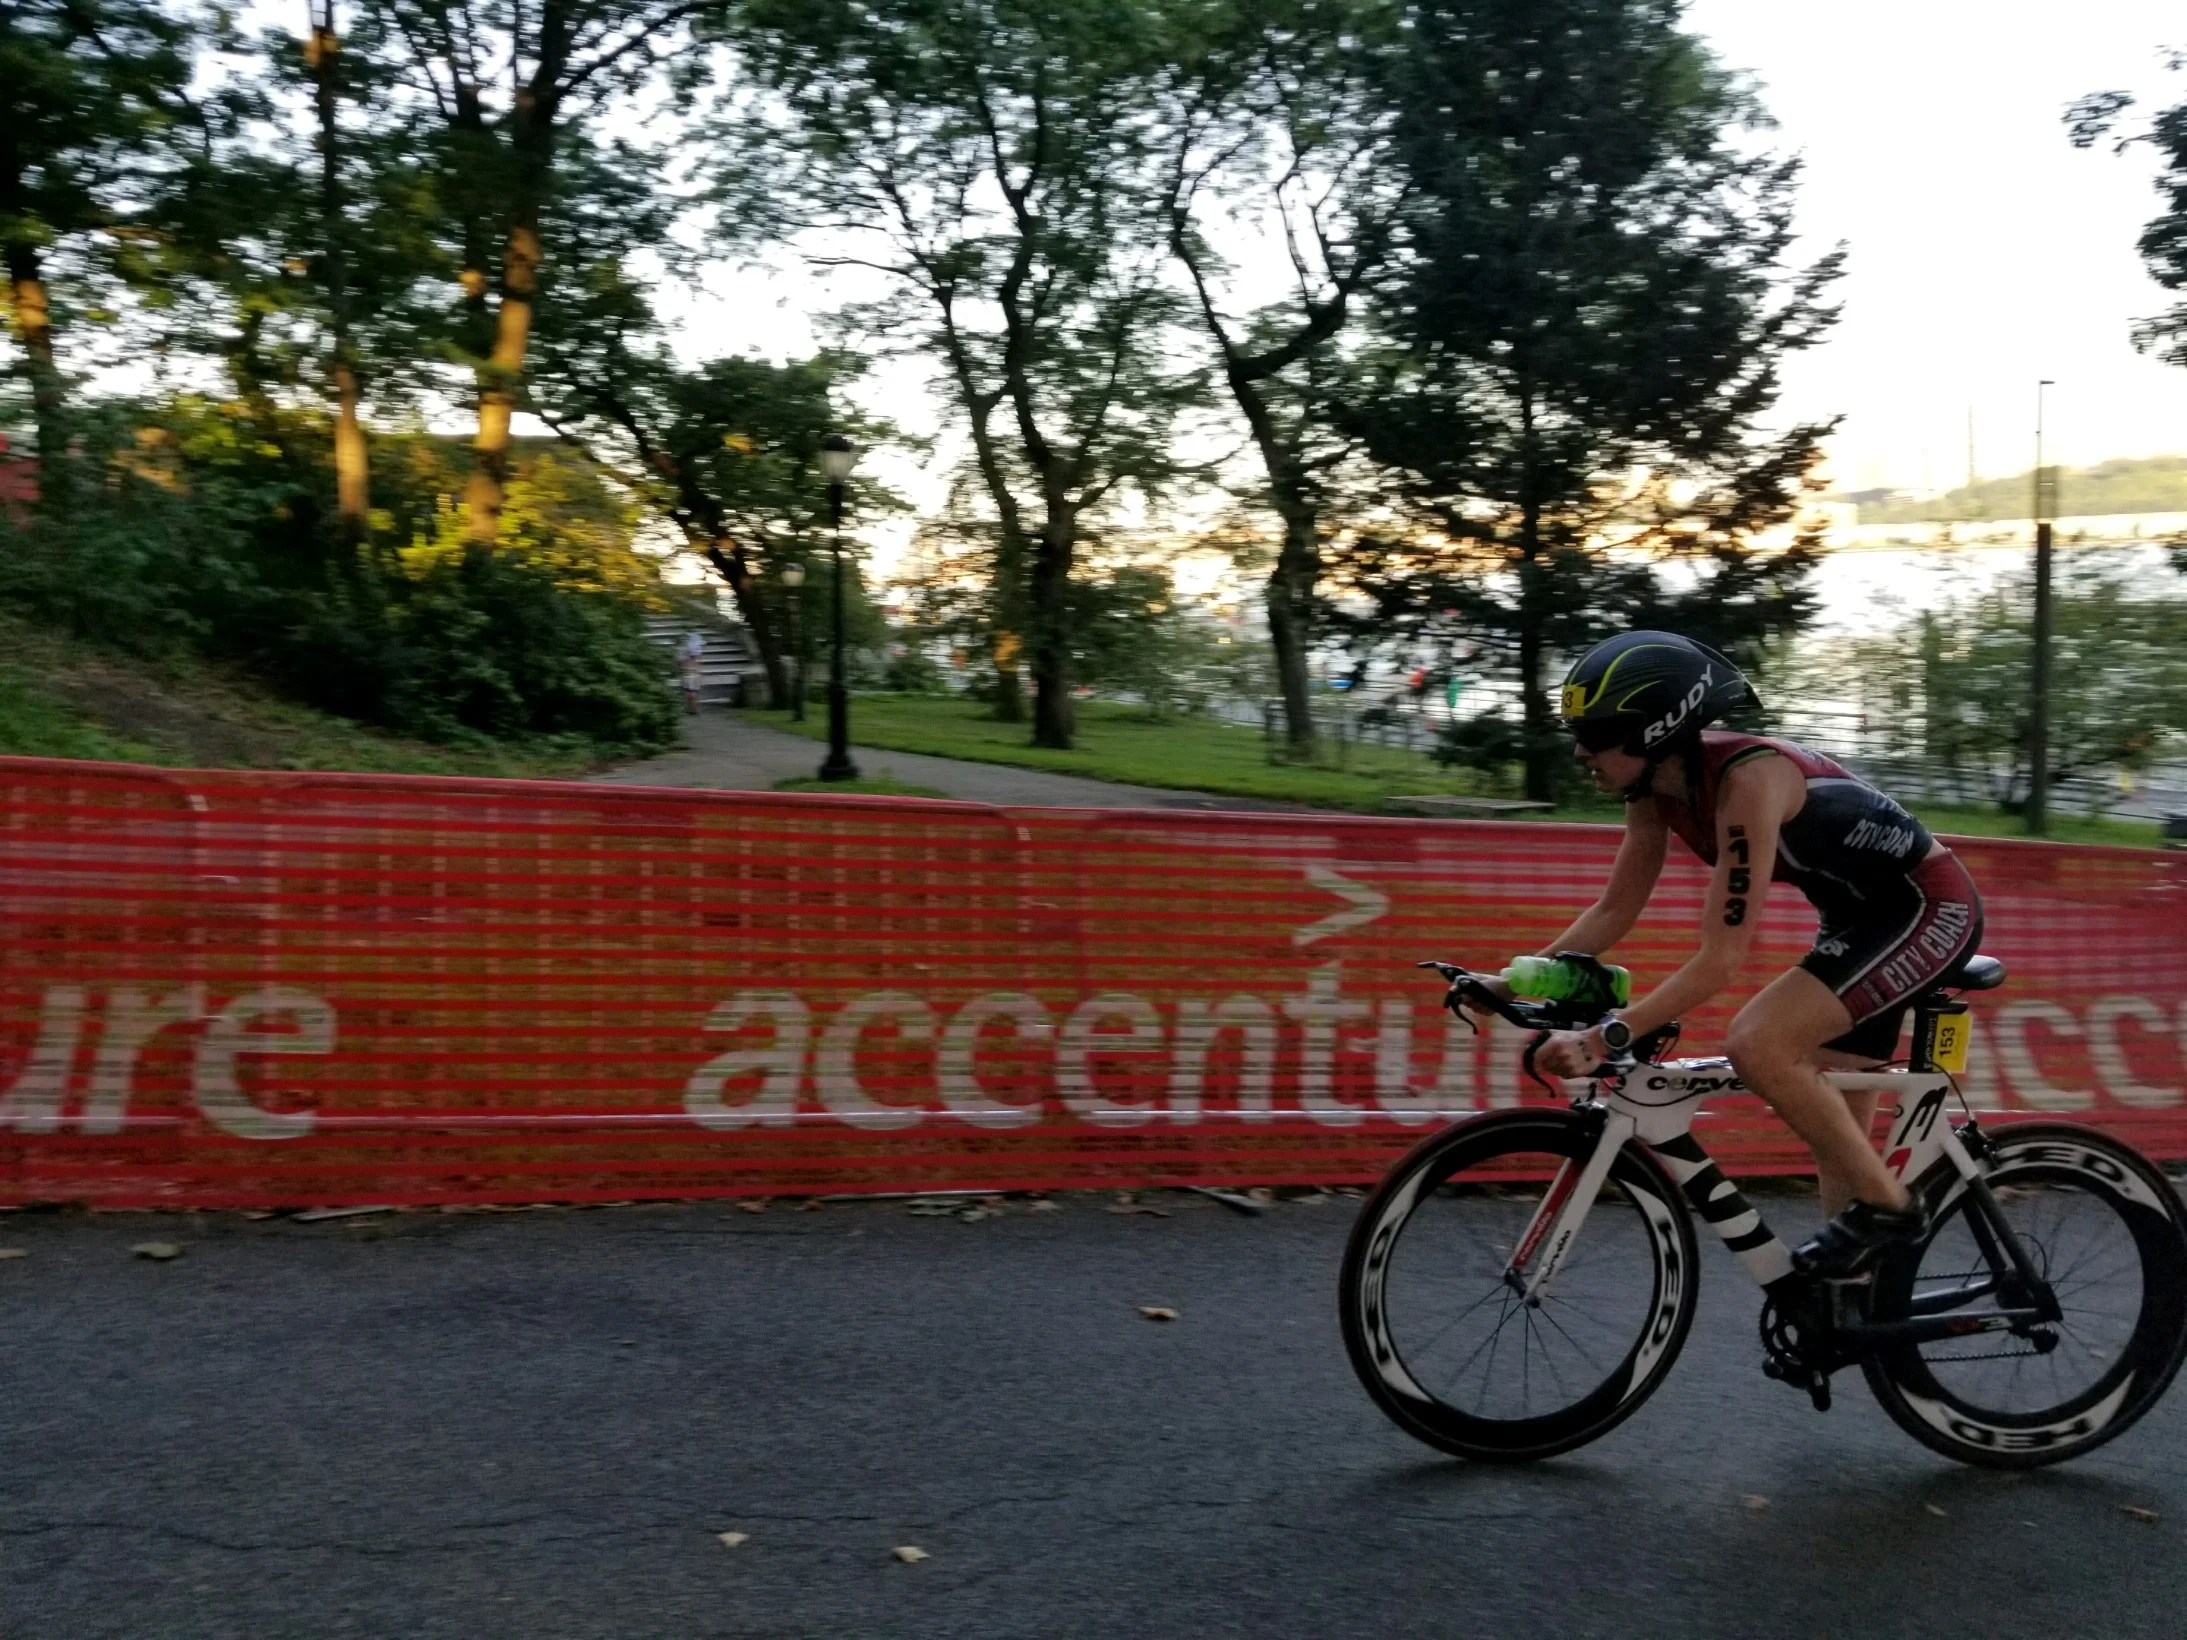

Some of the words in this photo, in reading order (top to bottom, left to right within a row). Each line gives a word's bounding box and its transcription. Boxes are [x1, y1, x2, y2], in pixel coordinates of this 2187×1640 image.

[1643, 663, 1713, 744] RUDY
[1723, 838, 1751, 927] 153
[1881, 945, 1931, 993] CITY
[1919, 901, 1969, 960] COACH
[683, 958, 1524, 1131] accentur
[1939, 1027, 1956, 1058] 153
